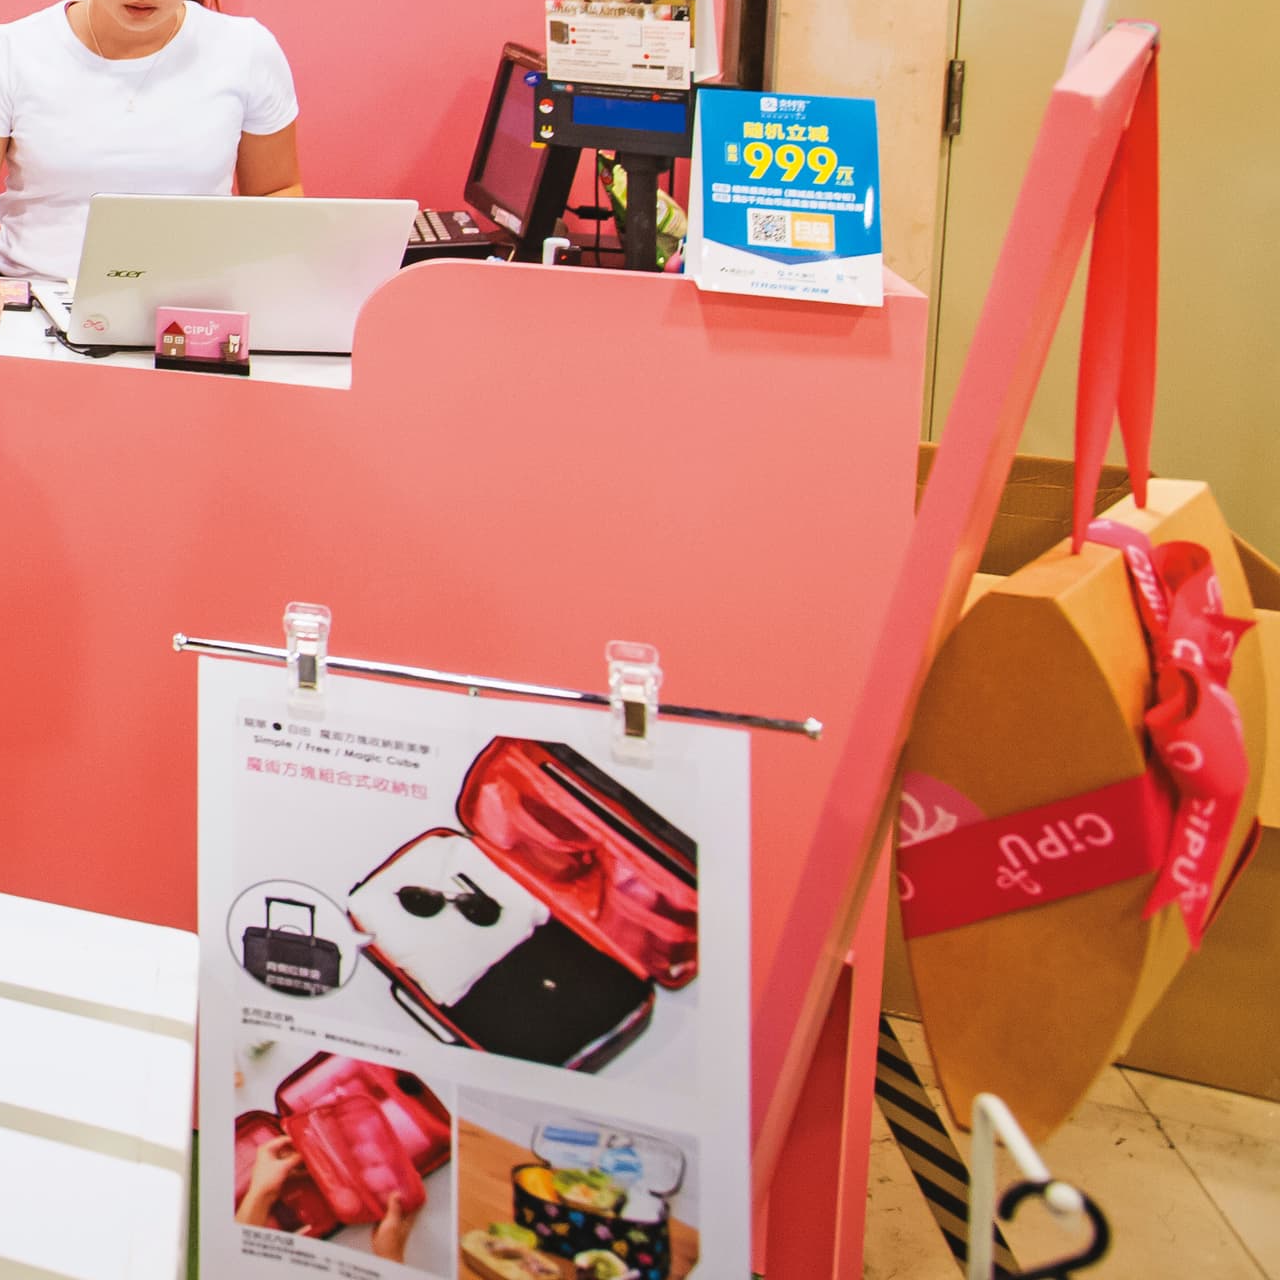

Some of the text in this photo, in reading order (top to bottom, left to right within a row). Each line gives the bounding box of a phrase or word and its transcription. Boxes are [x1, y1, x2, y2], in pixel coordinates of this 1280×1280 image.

[106, 269, 146, 279] acer
[253, 735, 293, 749] Simple
[305, 742, 331, 754] Free
[344, 749, 382, 763] Magic
[386, 756, 421, 769] Cube
[998, 813, 1114, 869] CiPU
